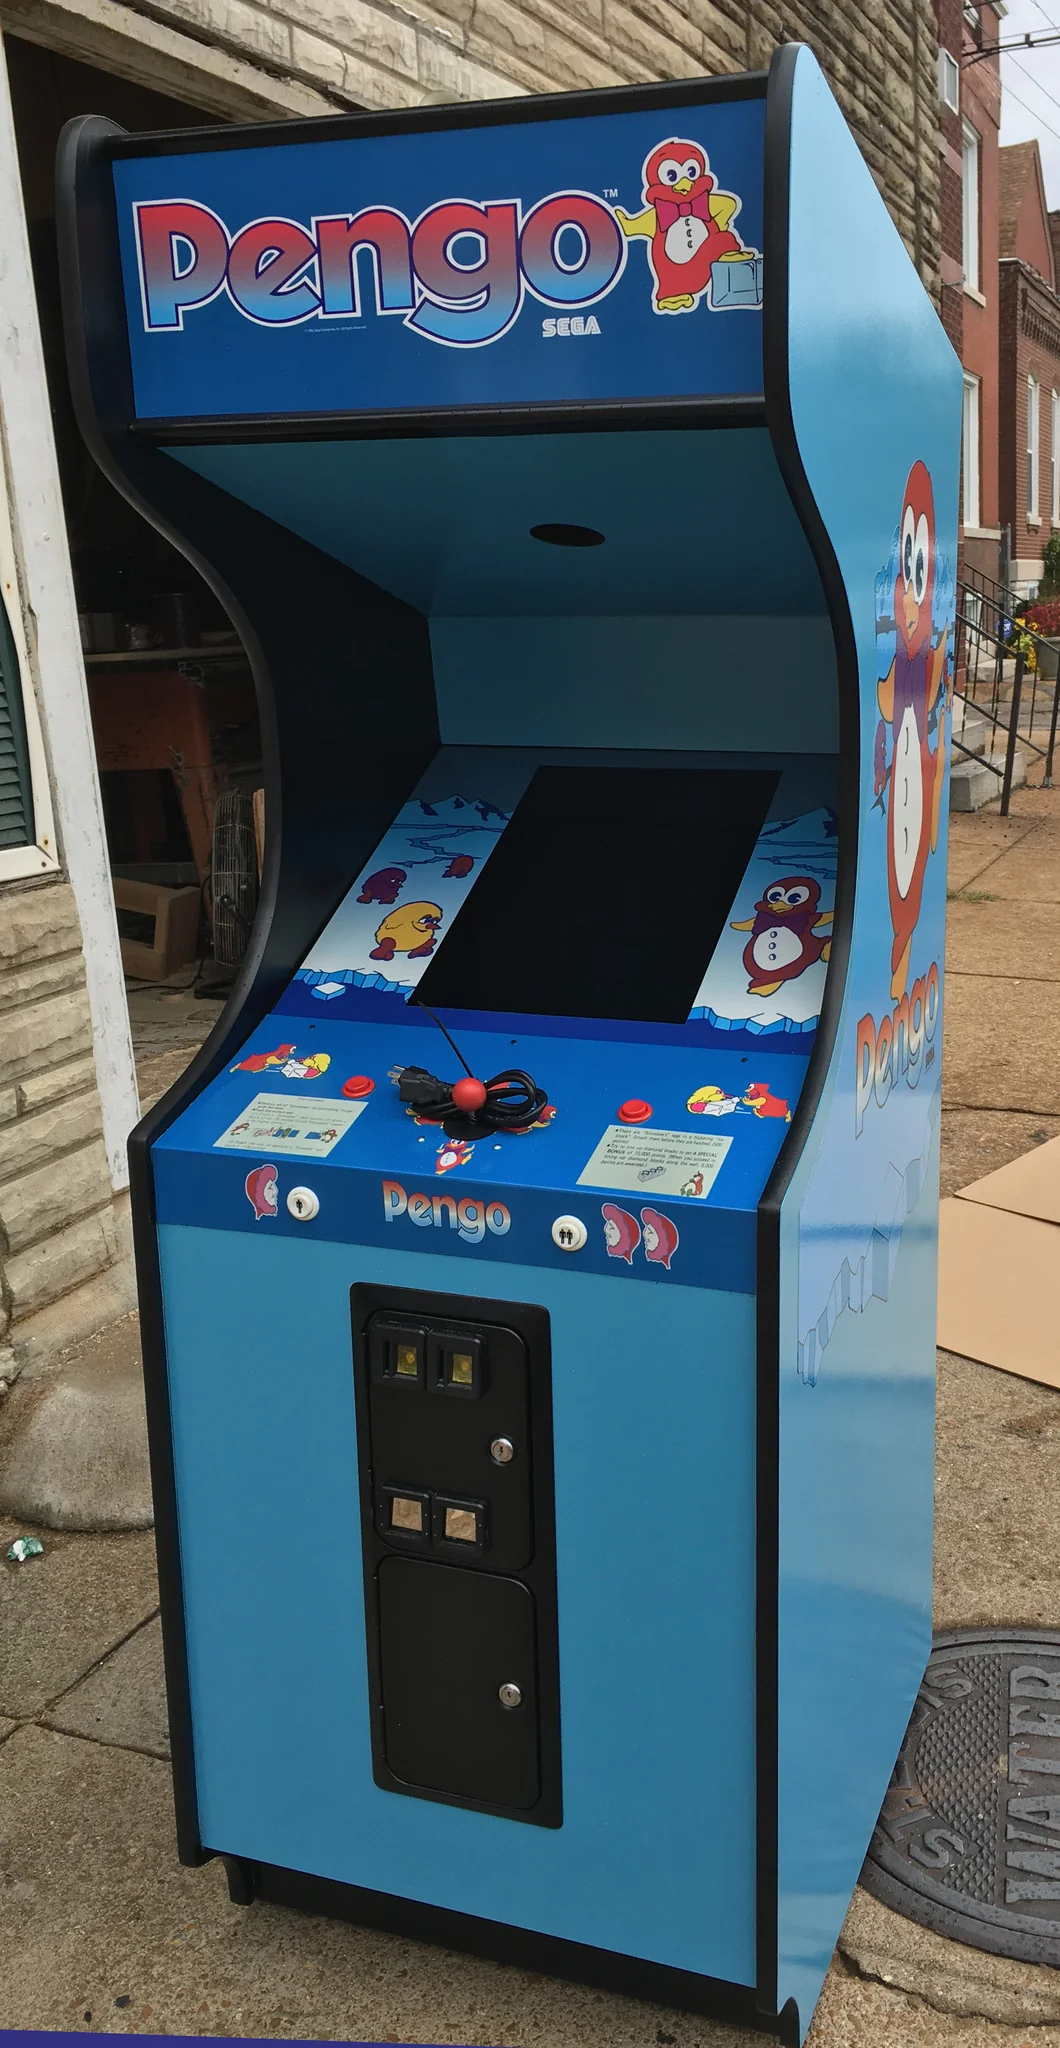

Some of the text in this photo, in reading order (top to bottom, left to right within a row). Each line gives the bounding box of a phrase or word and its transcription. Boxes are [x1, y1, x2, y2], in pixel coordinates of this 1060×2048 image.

[132, 189, 628, 348] Pengo TM
[542, 315, 602, 337] SEGA
[855, 961, 939, 1139] Pengo
[382, 1180, 511, 1243] Pengo
